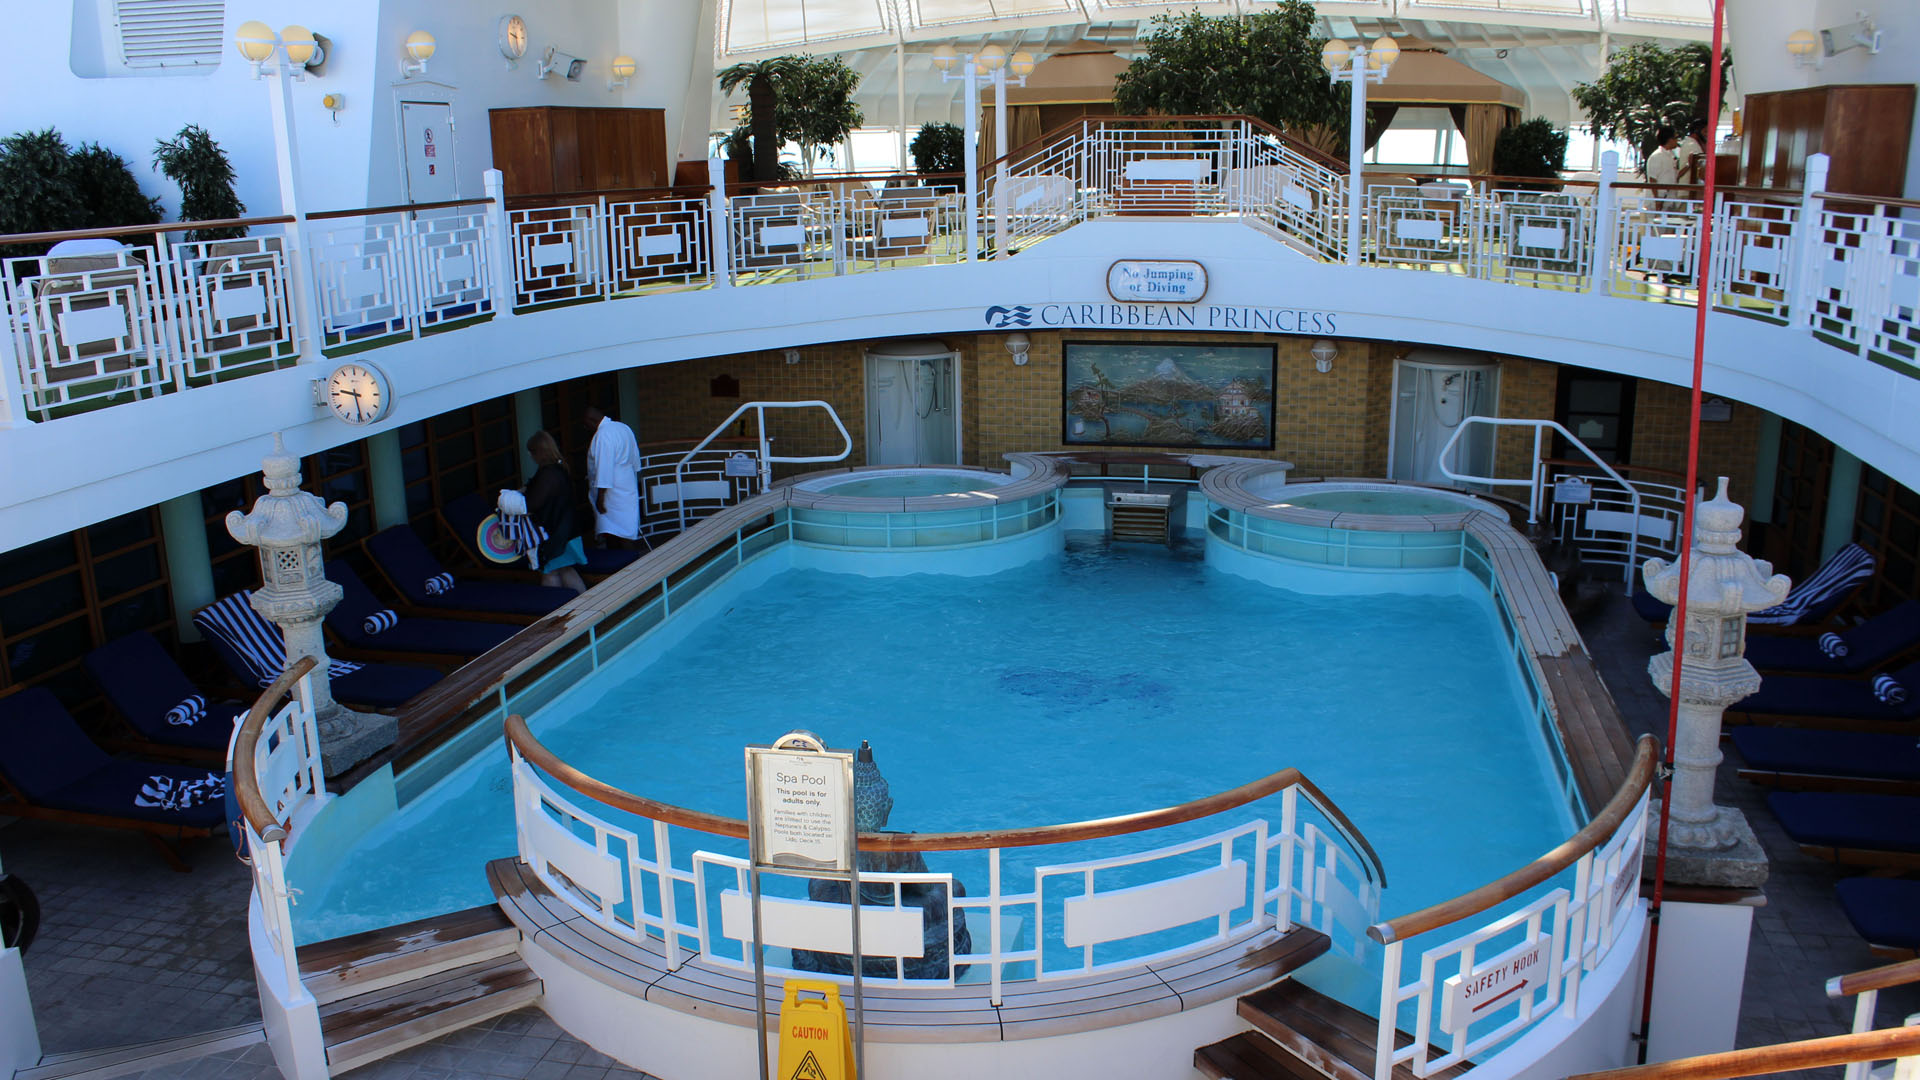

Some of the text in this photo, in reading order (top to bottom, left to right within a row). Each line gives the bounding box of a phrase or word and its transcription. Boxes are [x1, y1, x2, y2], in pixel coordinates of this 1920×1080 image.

[1123, 268, 1194, 281] No Jumping
[1129, 281, 1186, 294] or Diving
[1041, 304, 1337, 335] CARIBBEAN PRINCESS
[776, 772, 826, 785] Spa Pool
[776, 787, 791, 795] This
[782, 797, 804, 805] adults
[1464, 950, 1539, 999] SAFETY HOOK
[792, 1025, 829, 1041] CAUTION
